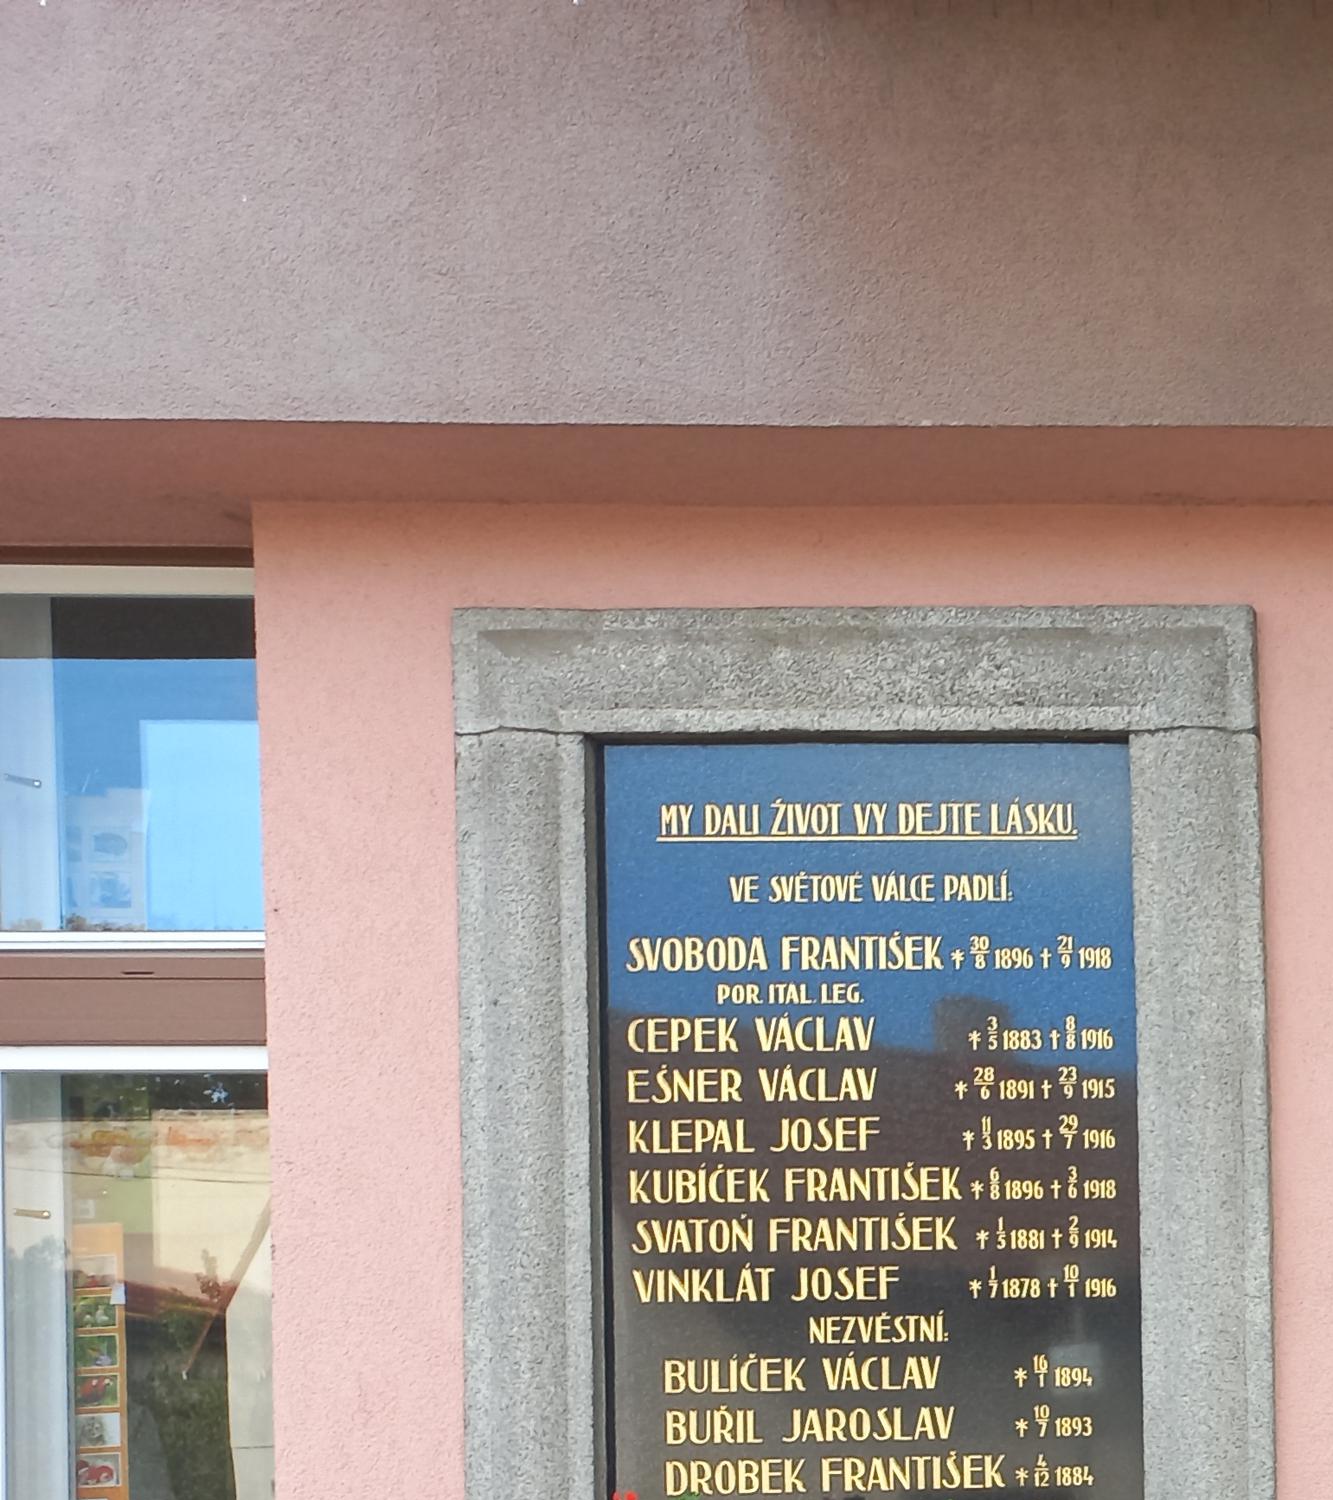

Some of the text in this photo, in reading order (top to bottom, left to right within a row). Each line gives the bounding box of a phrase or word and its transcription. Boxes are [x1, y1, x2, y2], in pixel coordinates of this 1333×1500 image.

[660, 797, 1078, 836] MY DALI ŽIVOT VY DEJTE LÁSKU.
[729, 875, 759, 903] VE
[769, 870, 863, 902] SVĚTOVÉ
[872, 870, 935, 902] VÁLCE
[626, 935, 767, 971] SVOBODA
[781, 931, 944, 970] FRANTIŠEK
[994, 948, 1034, 969] 1896
[1078, 947, 1112, 969] 1918
[820, 982, 864, 1004] LEG.
[754, 1012, 876, 1052] VÁCLAV
[1002, 1030, 1042, 1050] 1883
[1081, 1028, 1114, 1050] 1916
[758, 1064, 877, 1102] VÁCLAV
[999, 1079, 1034, 1100] 1891
[1082, 1078, 1115, 1099] 1915
[628, 1118, 755, 1154] KLEPAL
[770, 1116, 881, 1152] JOSEF
[997, 1129, 1035, 1150] 1895
[1083, 1129, 1116, 1149] 1916
[628, 1162, 1116, 1204] KUBÍČEK FRANTIŠEK 1896 1918
[769, 1212, 958, 1252] FRANTIŠEK
[1010, 1229, 1045, 1249] 1881
[1084, 1229, 1118, 1248] 1914
[632, 1263, 775, 1303] VINKLÁT
[791, 1265, 901, 1301] JOSEF
[1002, 1278, 1040, 1298] 1878
[1085, 1278, 1117, 1298] 1916
[663, 1352, 806, 1394] BULÍČEK
[822, 1354, 941, 1391] VÁCLAV
[1054, 1367, 1093, 1387] 1894
[664, 1405, 764, 1444] BUŘIL
[782, 1405, 955, 1442] JAROSLAV
[1055, 1417, 1093, 1437] 1893
[664, 1457, 806, 1496] DROBEK
[820, 1450, 1005, 1492] FRANTIŠEK
[1055, 1466, 1094, 1486] 1884
